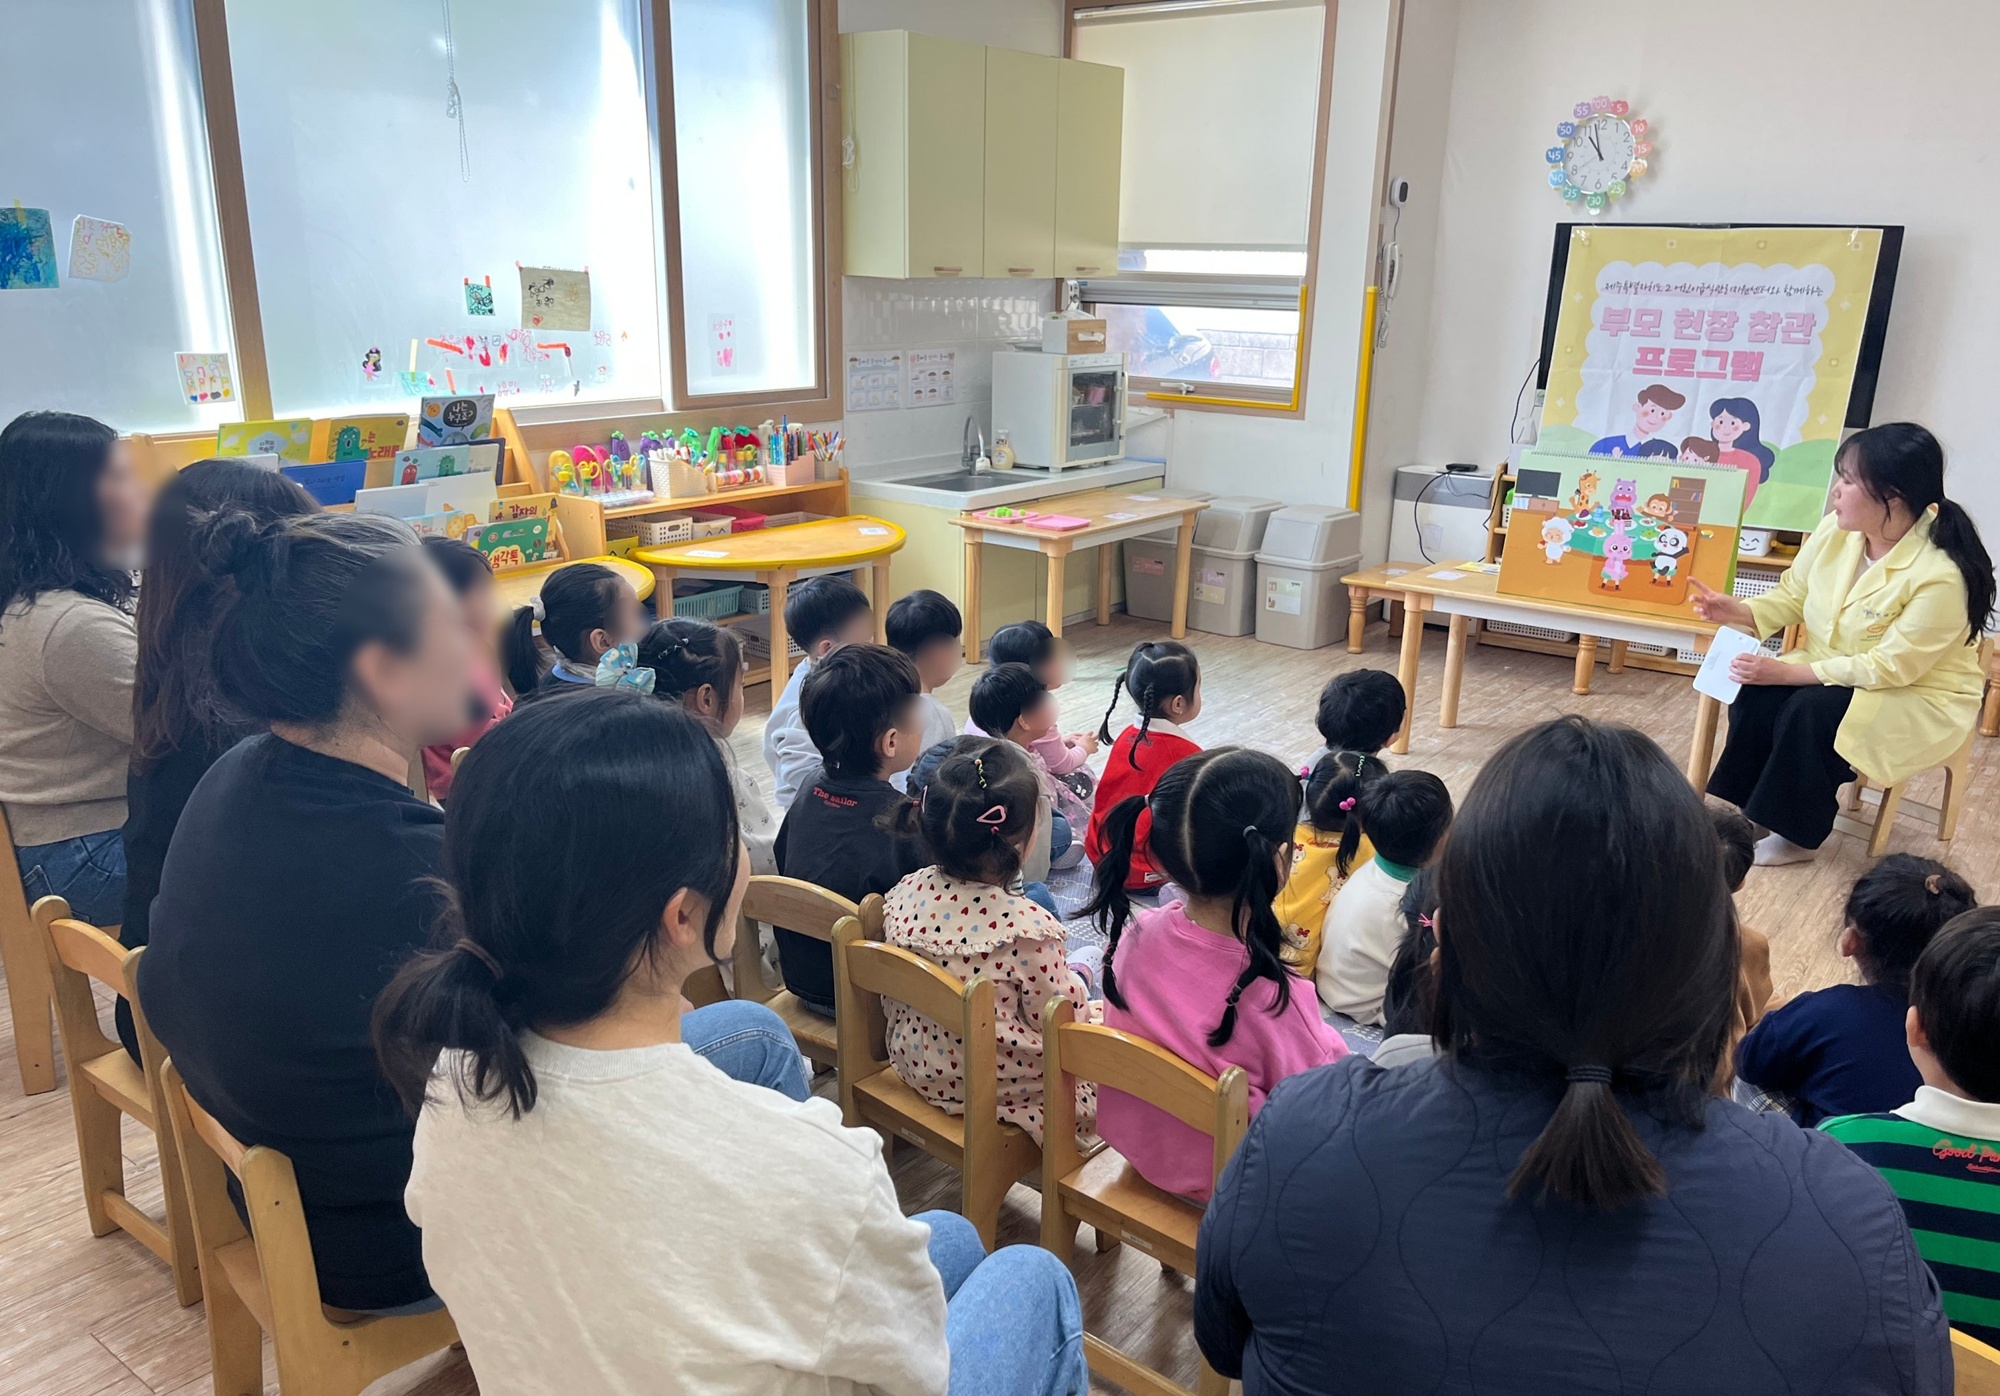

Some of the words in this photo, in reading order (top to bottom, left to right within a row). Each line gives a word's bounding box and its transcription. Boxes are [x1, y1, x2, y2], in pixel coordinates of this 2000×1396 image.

[1576, 105, 1589, 117] 55
[1616, 103, 1623, 113] 5
[1560, 125, 1572, 136] 50
[1598, 119, 1608, 130] 12
[1634, 123, 1645, 133] 10
[1573, 136, 1584, 148] 10
[1623, 131, 1631, 143] 2
[1626, 145, 1634, 157] 3
[1637, 143, 1648, 154] 15
[1548, 150, 1562, 161] 45
[1567, 151, 1574, 162] 9
[1571, 164, 1578, 176] 8
[1620, 160, 1628, 171] 4
[1580, 174, 1588, 187] 7
[1594, 178, 1602, 190] 6
[1565, 189, 1577, 199] 35
[1610, 184, 1622, 194] 25
[1589, 196, 1602, 207] 30
[1783, 283, 1824, 297] 함께하는
[1600, 307, 1663, 337] 부모
[1673, 308, 1740, 342] 현장
[1747, 311, 1817, 345] 참관
[1632, 346, 1765, 382] 프로그램
[452, 401, 469, 413] 나는
[508, 504, 538, 519] 감자의
[813, 786, 829, 799] The
[831, 795, 858, 806] sailor
[1932, 1139, 1976, 1159] Good
